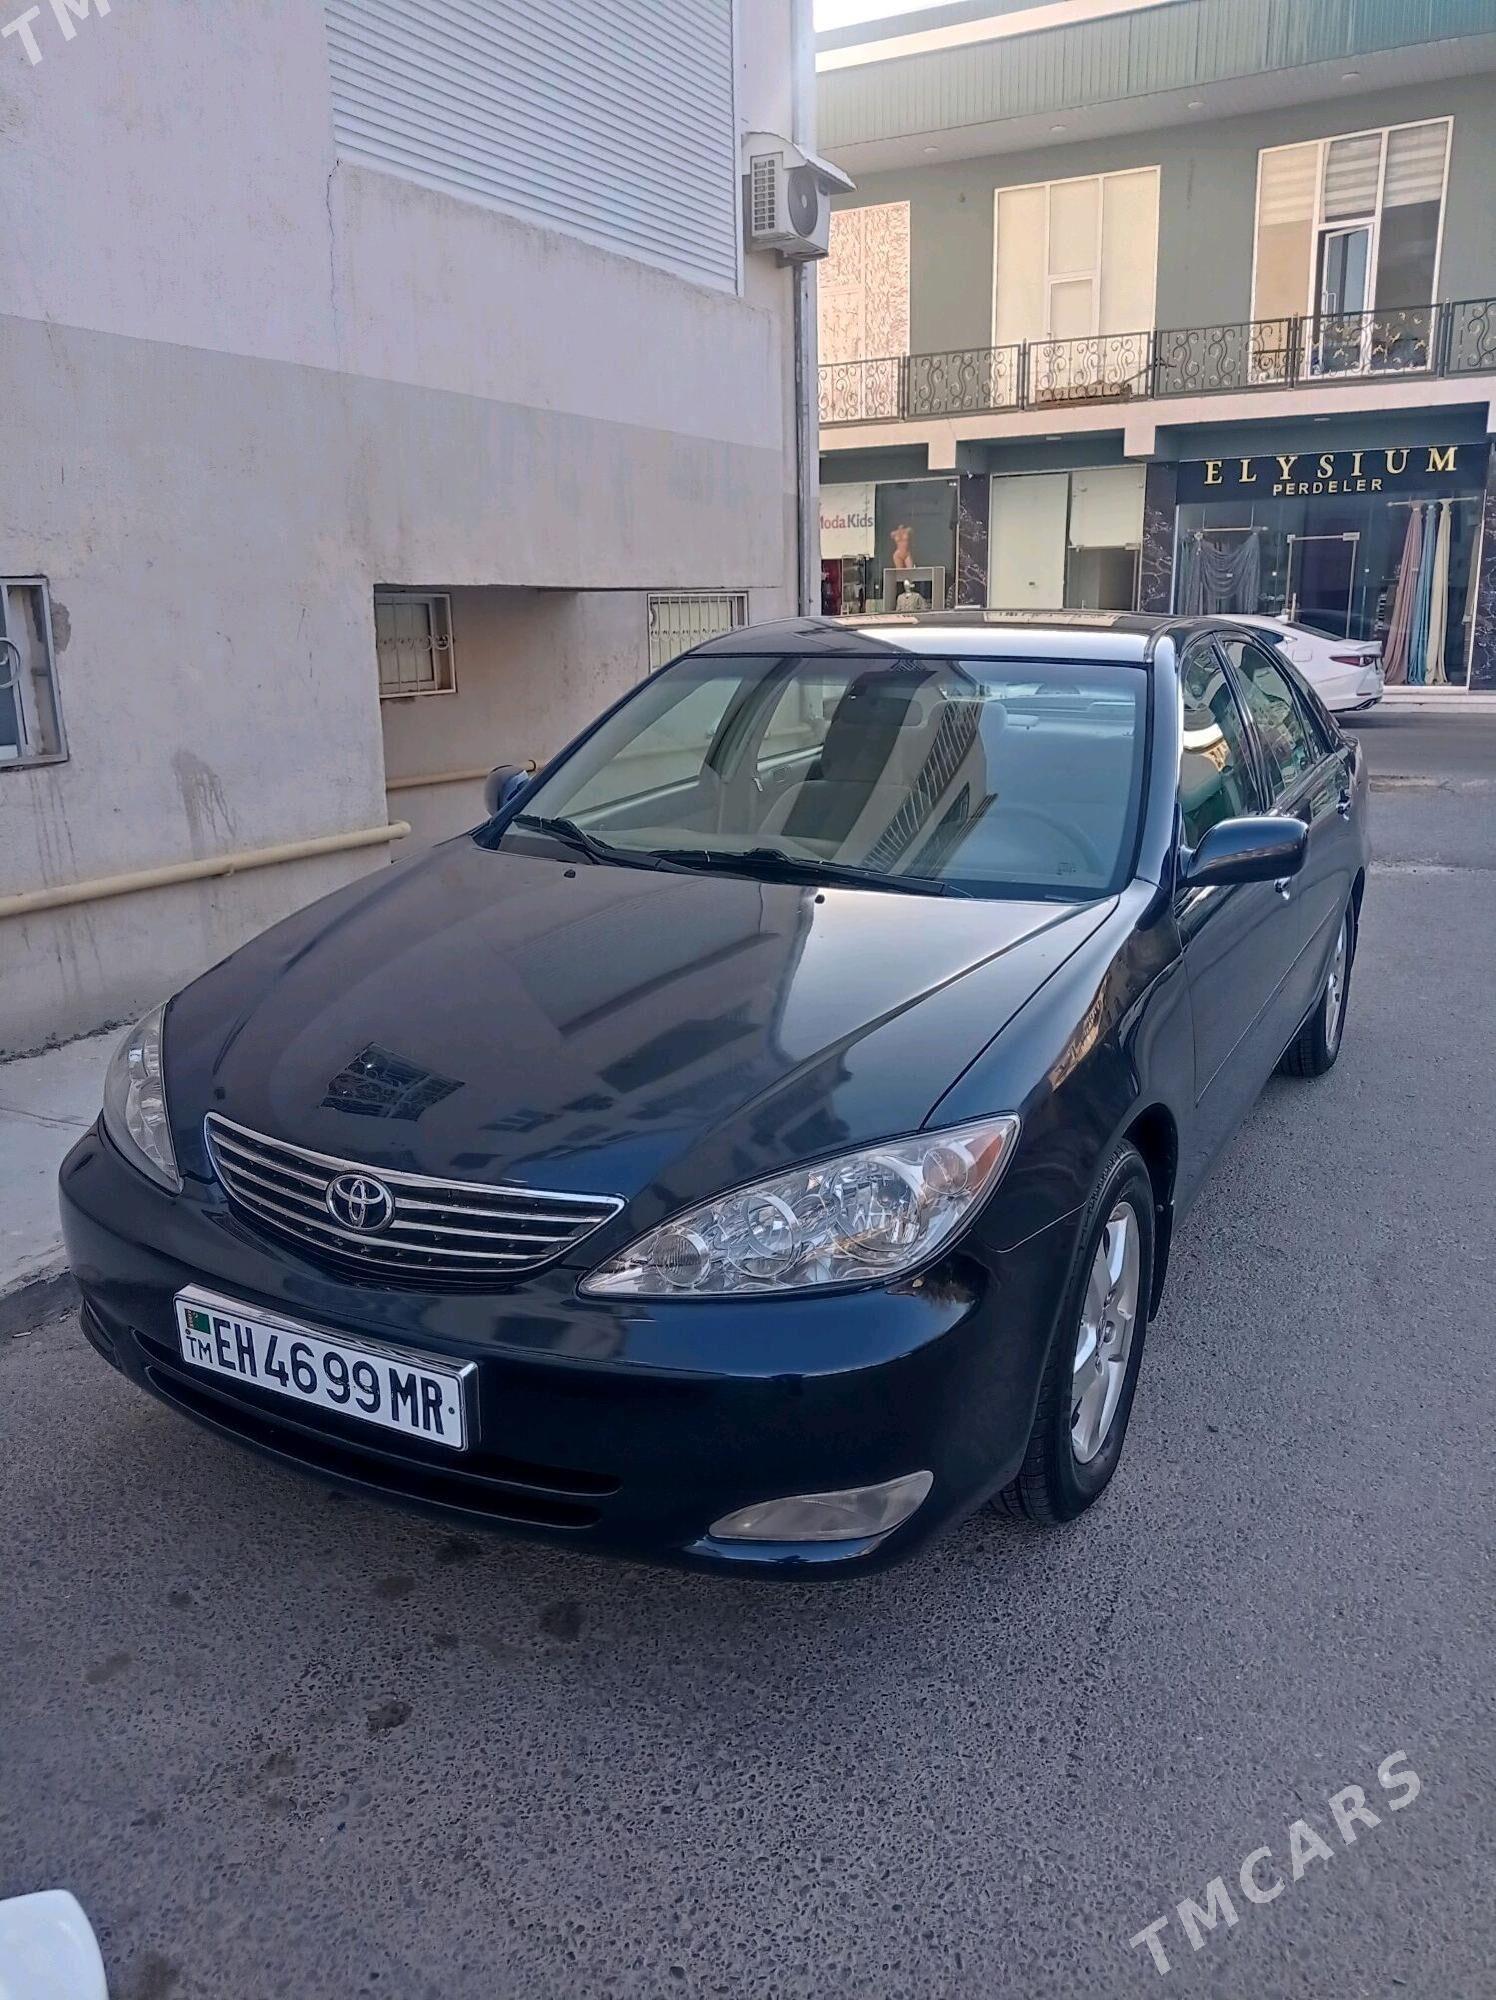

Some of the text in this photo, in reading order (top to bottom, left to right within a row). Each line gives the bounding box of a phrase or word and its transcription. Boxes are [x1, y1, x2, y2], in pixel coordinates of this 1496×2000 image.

[1204, 446, 1458, 485] ELYSIUM
[1272, 478, 1383, 496] PERDELER
[186, 1335, 213, 1364] TM
[264, 1335, 382, 1414] 4699
